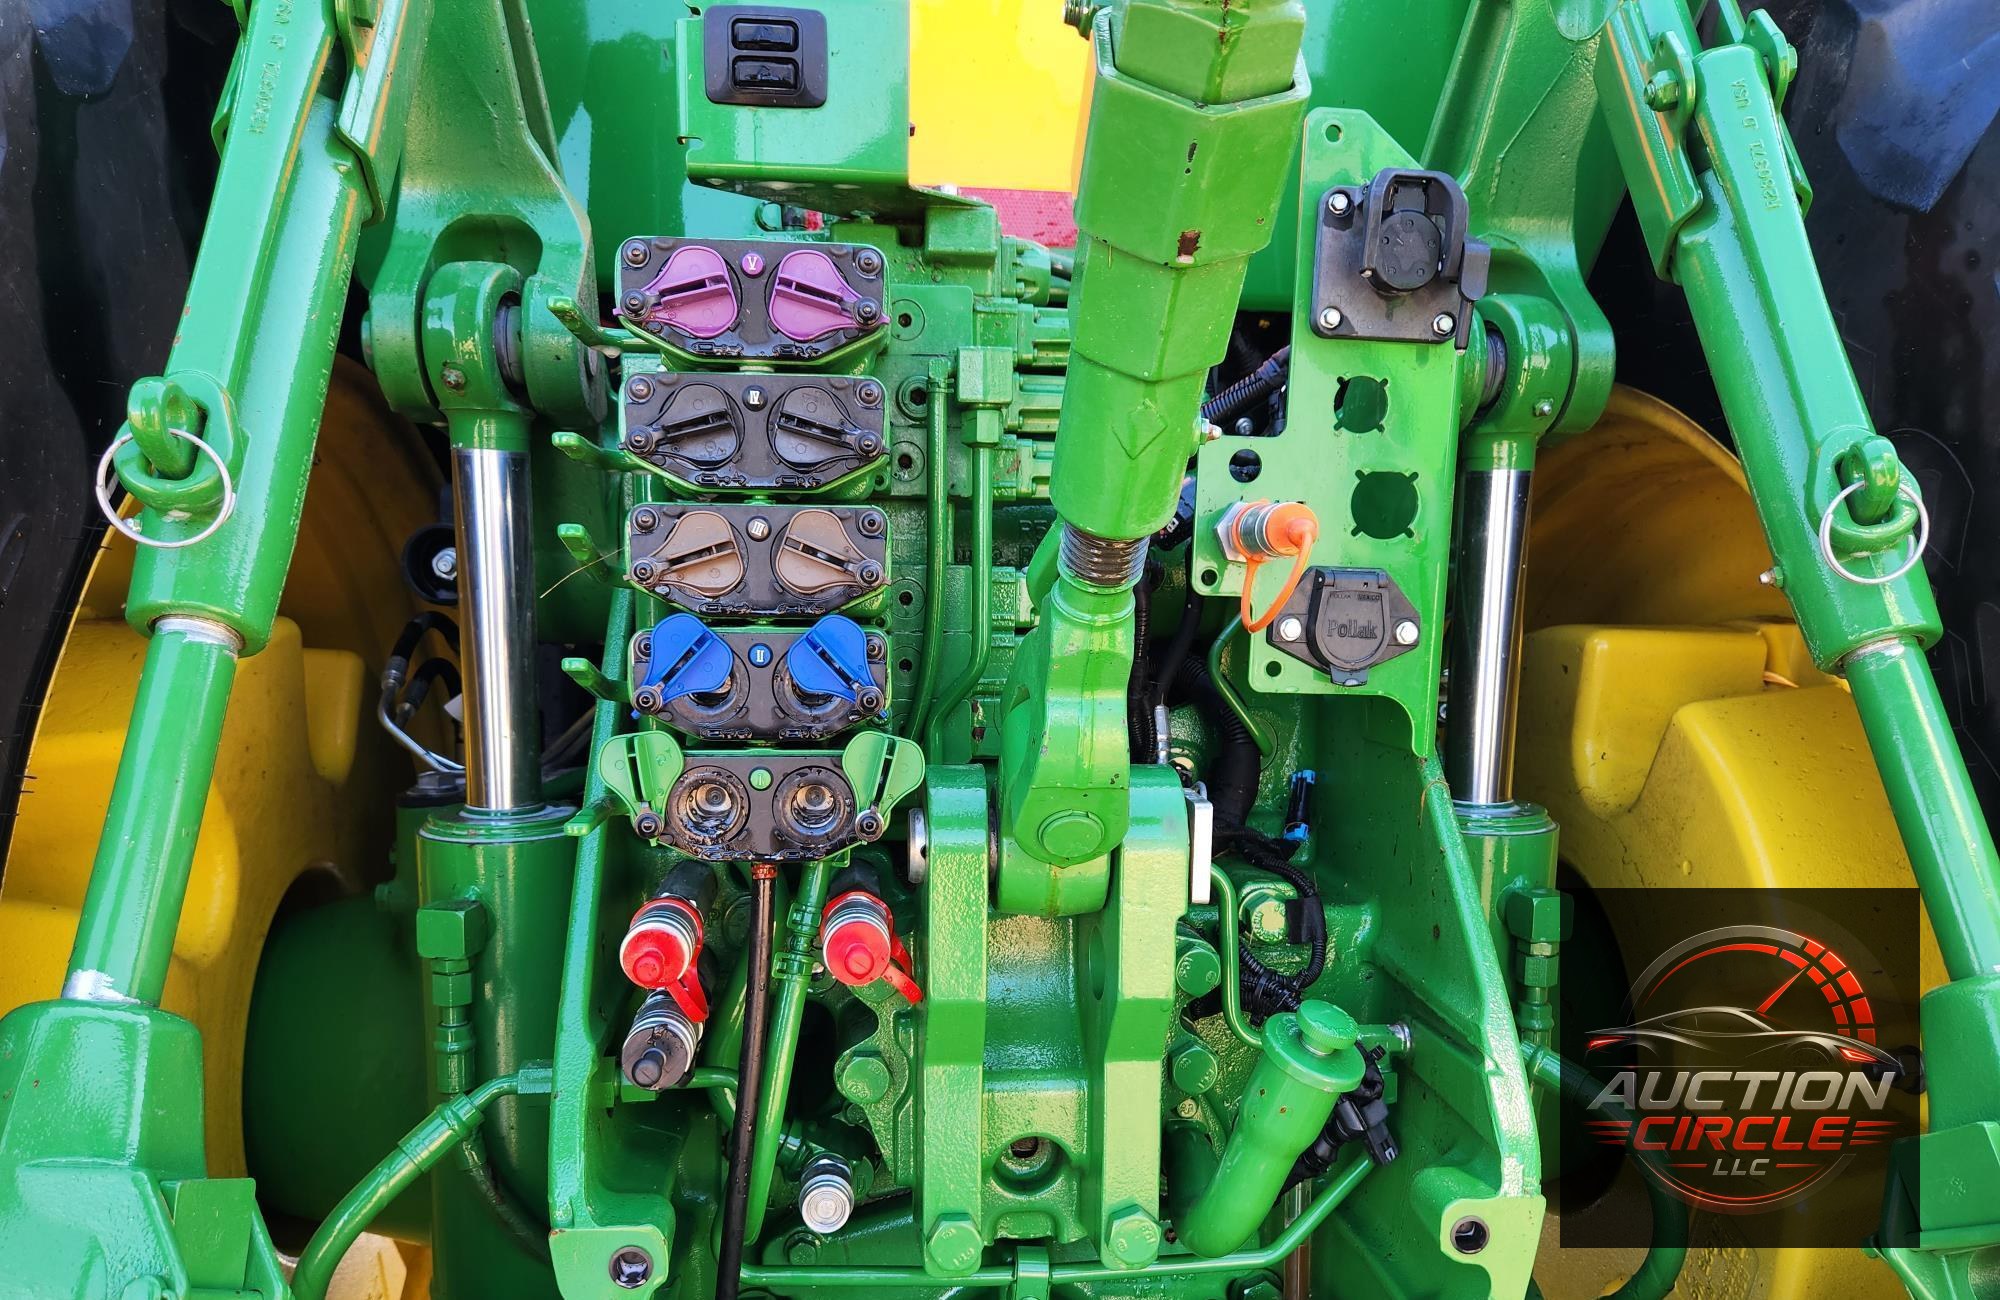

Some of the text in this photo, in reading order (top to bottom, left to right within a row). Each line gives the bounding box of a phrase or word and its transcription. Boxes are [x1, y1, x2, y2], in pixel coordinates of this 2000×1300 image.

[1731, 77, 1752, 109] USA
[746, 256, 758, 271] V
[749, 390, 761, 405] IV
[752, 522, 765, 536] III
[1327, 619, 1378, 639] Pollak
[755, 649, 765, 663] II
